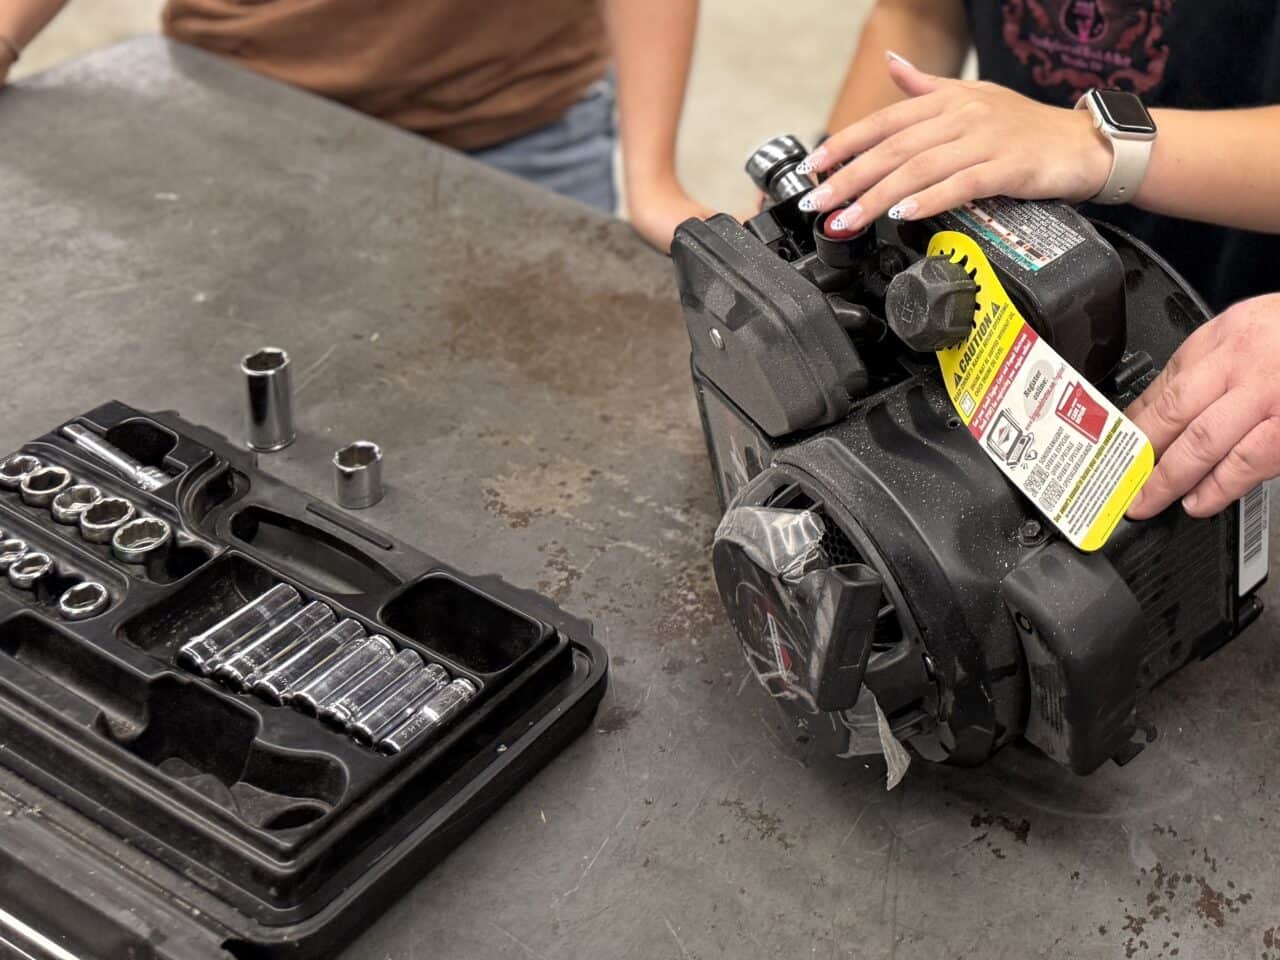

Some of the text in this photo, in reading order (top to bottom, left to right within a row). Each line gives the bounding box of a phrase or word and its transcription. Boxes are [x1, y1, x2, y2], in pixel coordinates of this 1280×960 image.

[957, 312, 993, 373] CAUTION
[1023, 369, 1041, 398] Register
[1033, 377, 1047, 401] online:
